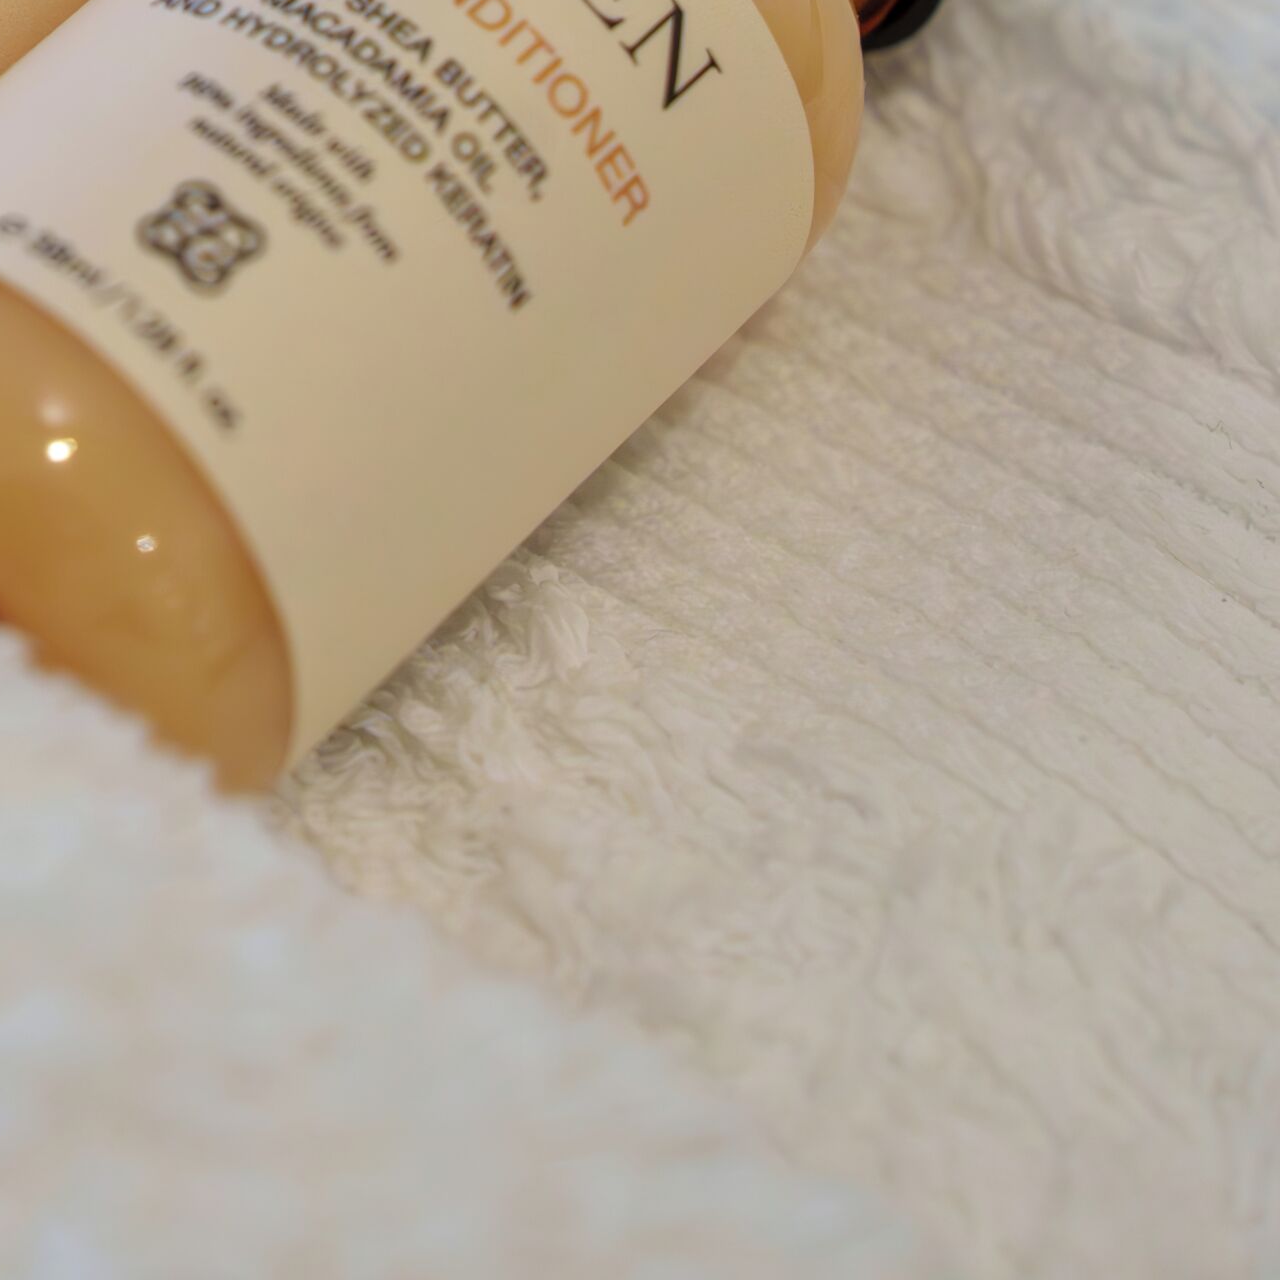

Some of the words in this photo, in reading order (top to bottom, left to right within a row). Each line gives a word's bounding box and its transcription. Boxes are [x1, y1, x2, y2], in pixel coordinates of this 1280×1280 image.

[218, 6, 431, 165] HYDROLYZED
[425, 160, 533, 313] KERATIN
[432, 57, 550, 203] BUTTER,
